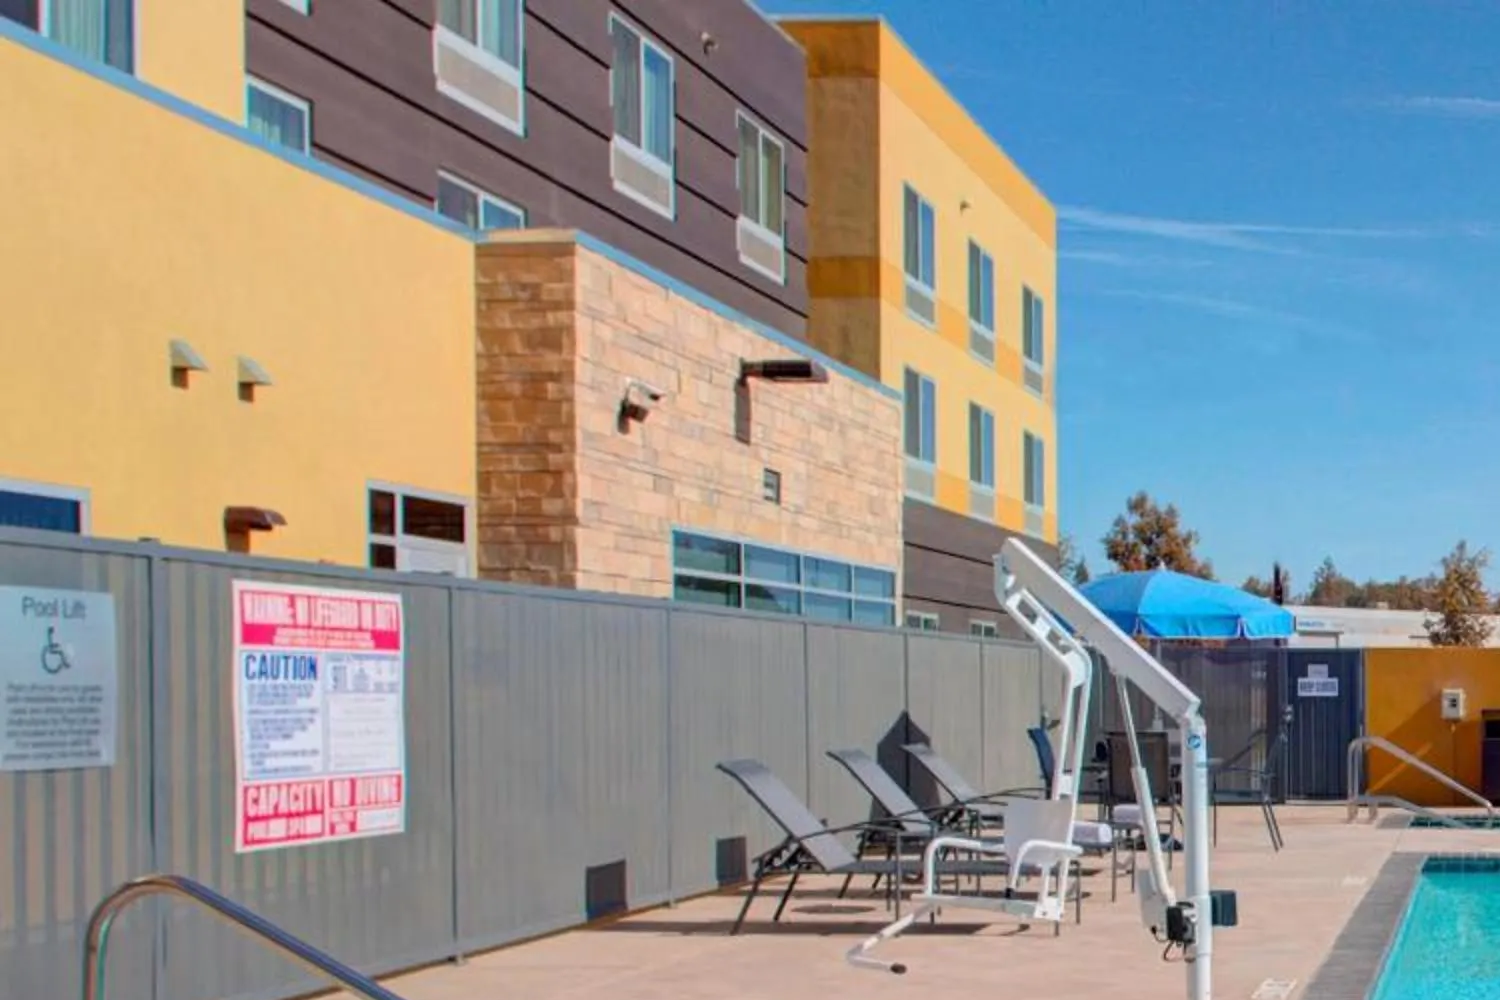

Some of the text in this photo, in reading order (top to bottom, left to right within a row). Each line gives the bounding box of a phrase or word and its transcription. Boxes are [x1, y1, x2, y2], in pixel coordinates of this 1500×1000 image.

[22, 596, 59, 617] Pool
[245, 654, 318, 681] CAUTION
[246, 781, 324, 817] CAPACITY
